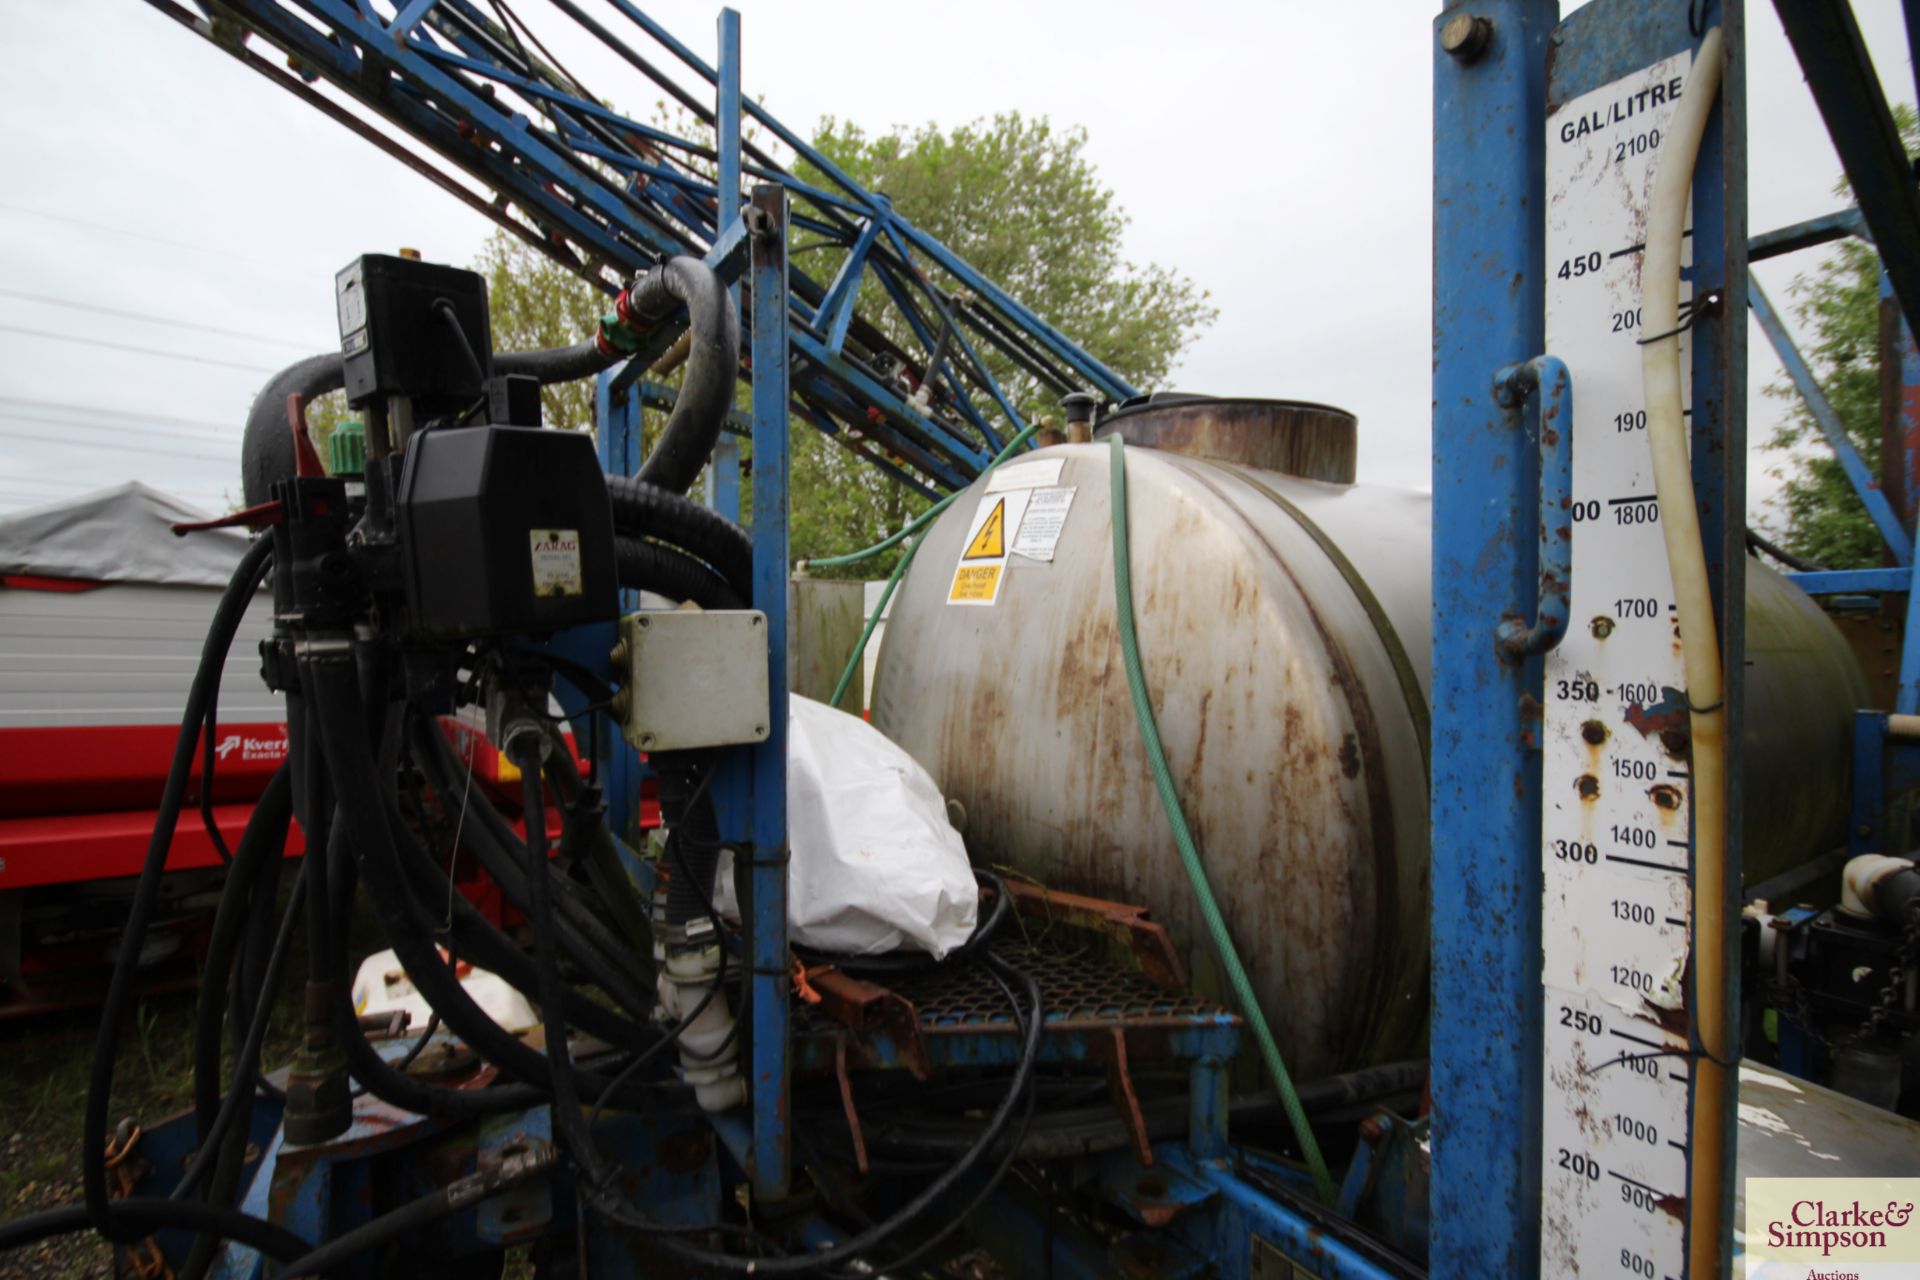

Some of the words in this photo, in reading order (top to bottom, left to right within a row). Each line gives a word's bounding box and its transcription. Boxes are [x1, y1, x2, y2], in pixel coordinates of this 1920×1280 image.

[1560, 76, 1683, 144] GAL/LITRE
[1615, 128, 1660, 163] 2100
[1557, 251, 1602, 281] 450
[1613, 410, 1648, 433] 190
[1571, 500, 1601, 522] 00
[1613, 502, 1659, 526] 1800
[958, 567, 996, 581] DANGER
[1613, 598, 1658, 618] 1700
[1557, 680, 1600, 701] 350
[1617, 683, 1658, 703] 1600
[1611, 758, 1657, 781] 1500
[1610, 824, 1657, 849] 1400
[1554, 839, 1599, 865] 300
[1610, 899, 1656, 926] 1300
[1610, 965, 1654, 994] 1200
[1559, 1006, 1603, 1037] 250
[1617, 1049, 1659, 1080] 1100
[1614, 1113, 1658, 1146] 1000
[1558, 1148, 1601, 1182] 200
[1620, 1182, 1657, 1215] 900
[1620, 1248, 1655, 1280] 800
